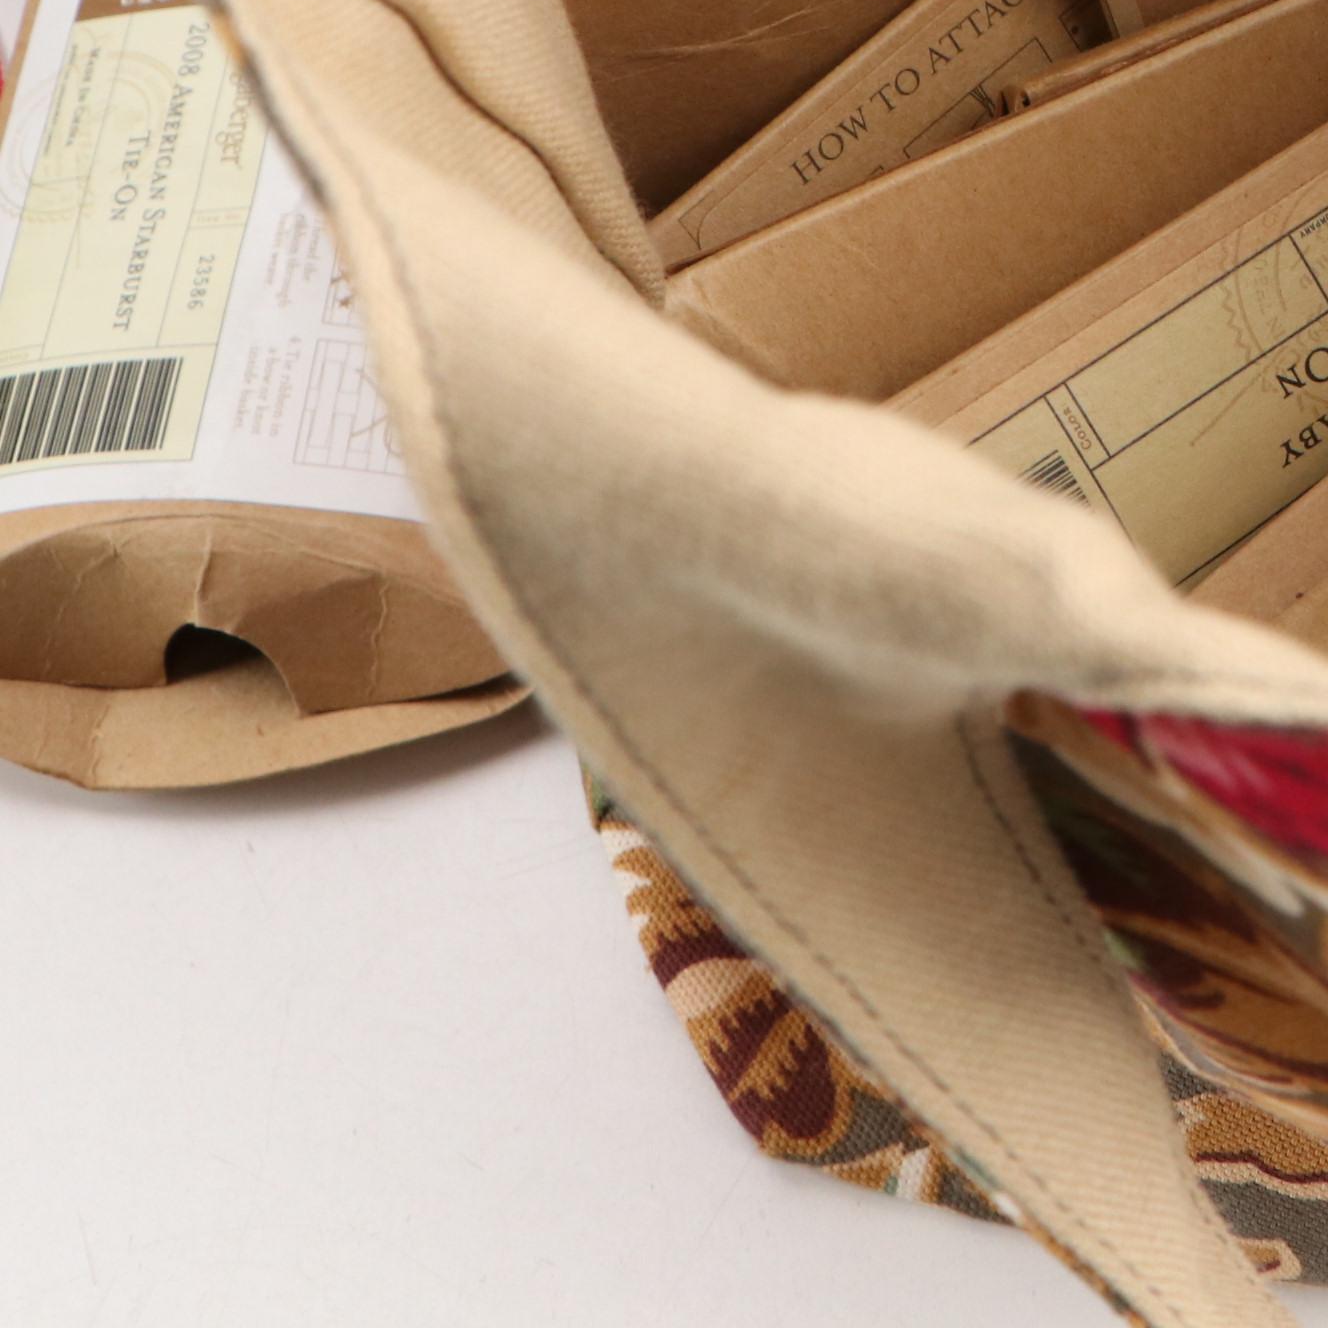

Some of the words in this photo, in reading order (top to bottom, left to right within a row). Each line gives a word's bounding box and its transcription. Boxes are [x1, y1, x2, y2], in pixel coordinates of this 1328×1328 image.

[176, 22, 210, 78] 2008
[109, 129, 151, 221] TIE-ON
[149, 83, 194, 201] AMERICAN
[788, 105, 871, 185] HOW
[869, 67, 923, 117] TO
[111, 207, 167, 333] STARBURST
[186, 253, 216, 311] 23586
